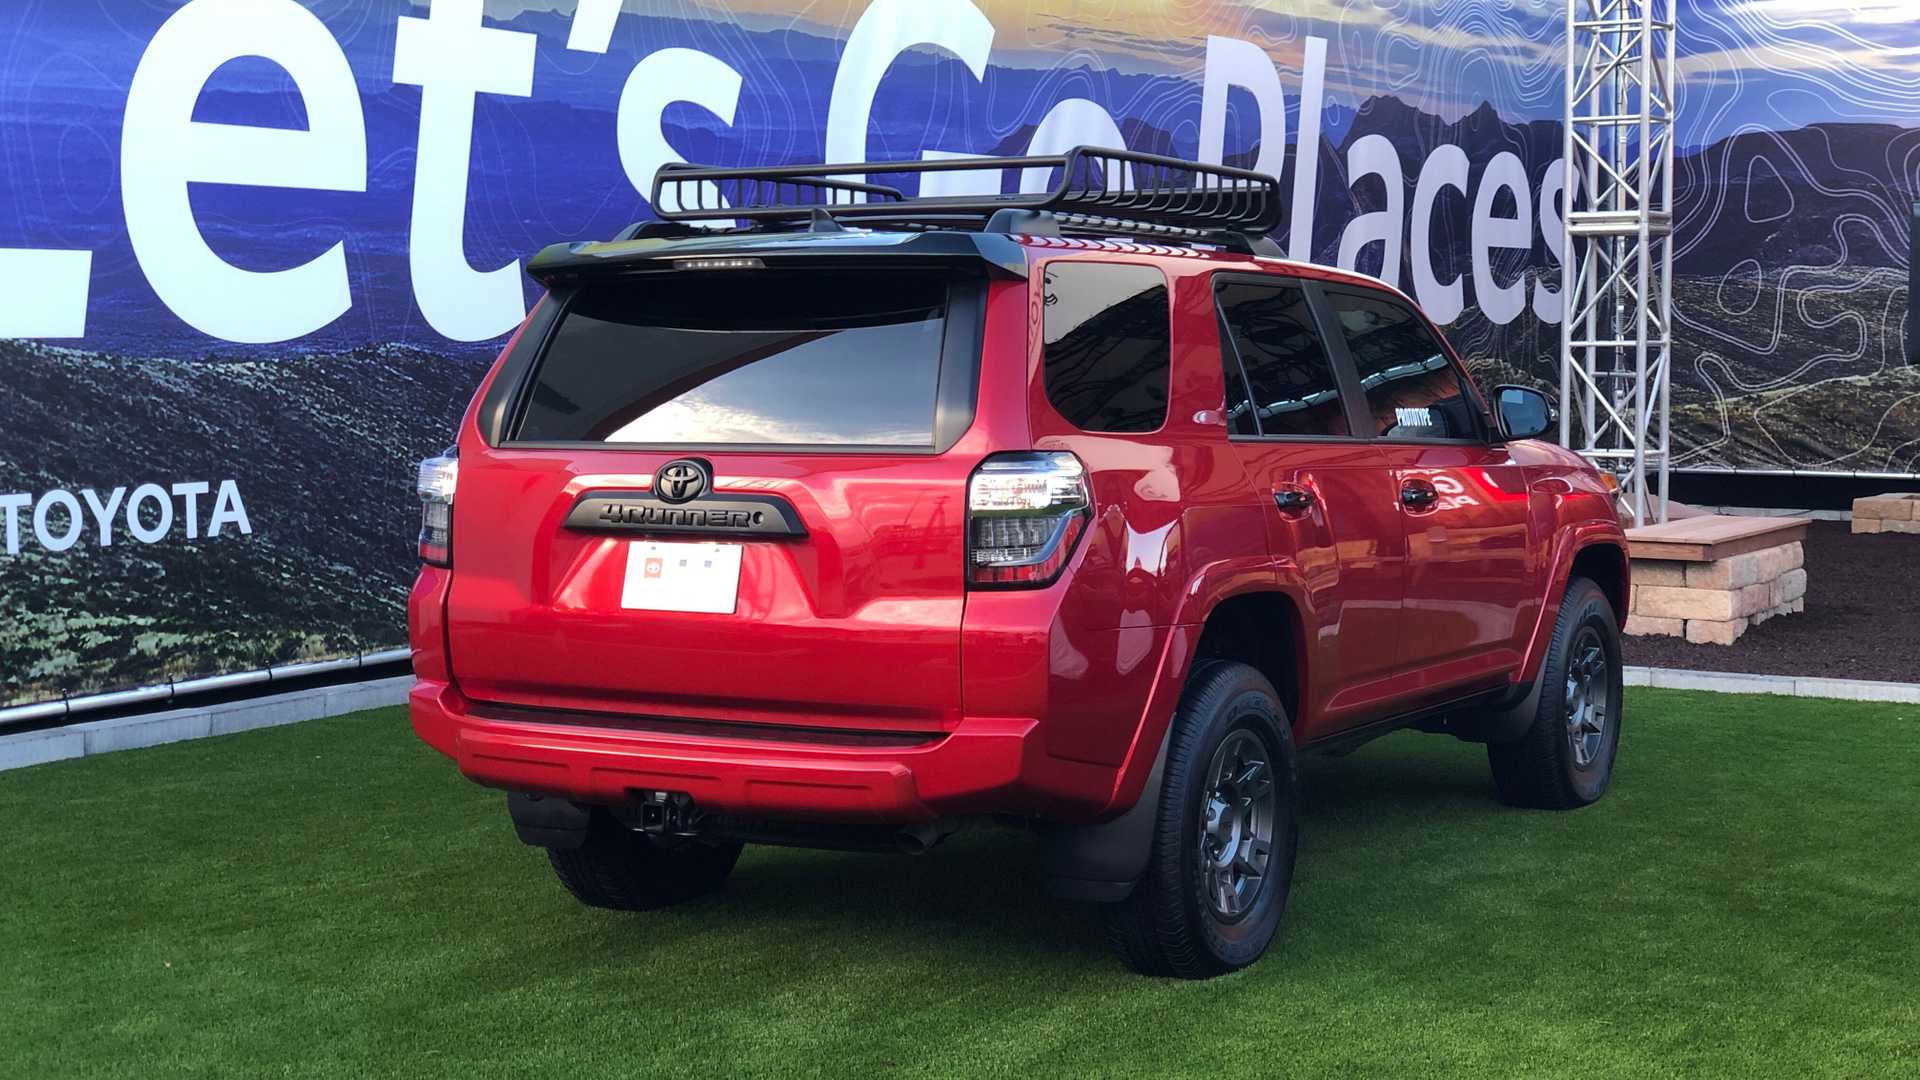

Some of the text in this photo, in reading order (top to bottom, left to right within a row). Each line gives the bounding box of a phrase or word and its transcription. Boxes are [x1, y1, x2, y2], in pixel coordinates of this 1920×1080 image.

[1199, 35, 1581, 325] Places
[1395, 408, 1432, 426] PROTOTYPE
[0, 480, 252, 554] TOYOTA
[600, 504, 749, 527] 4RUNNER
